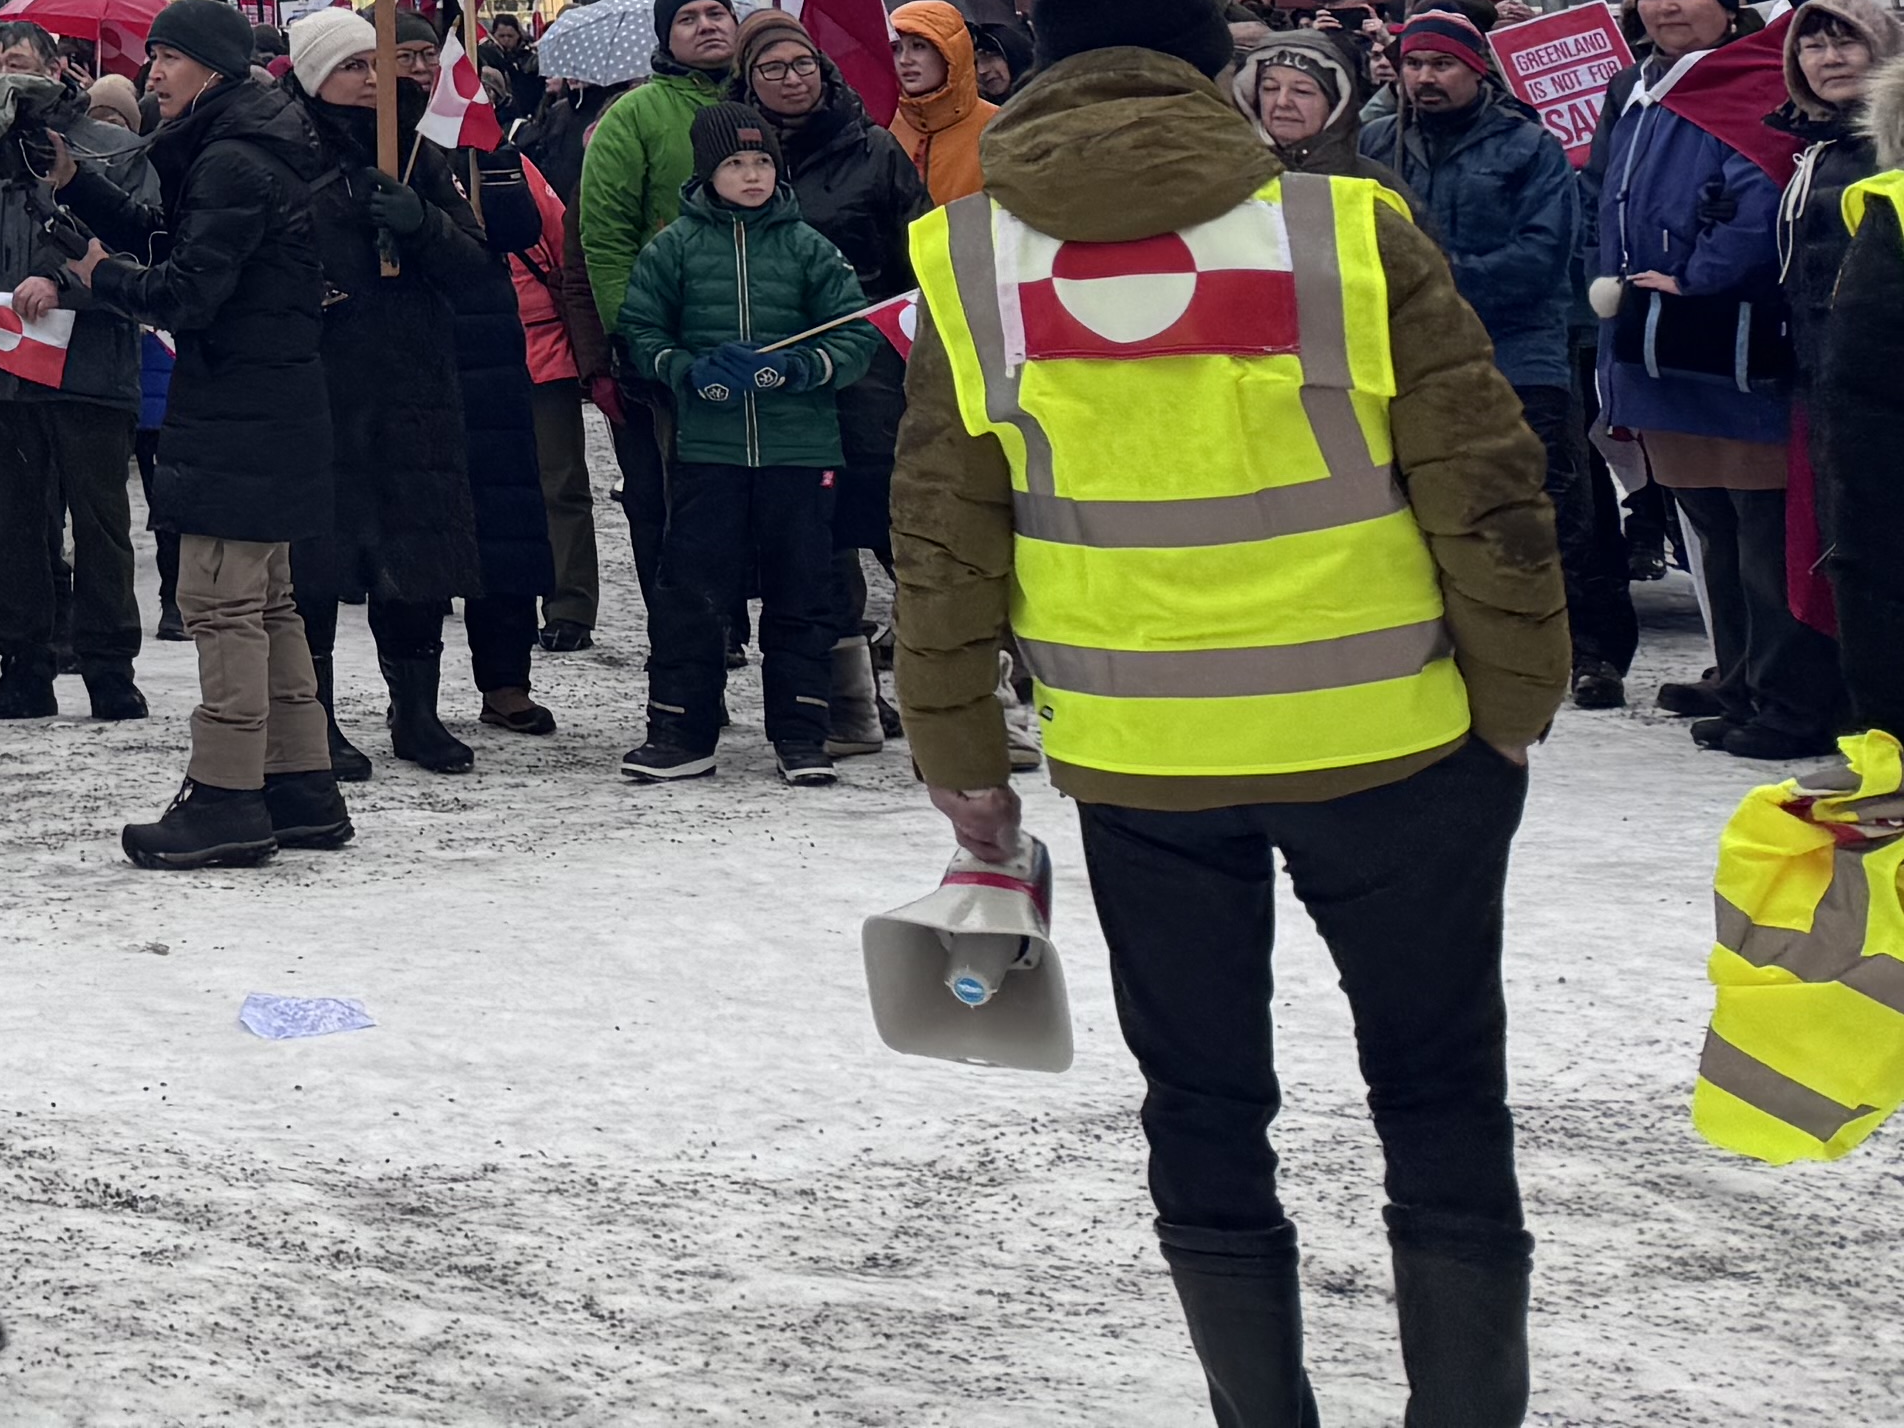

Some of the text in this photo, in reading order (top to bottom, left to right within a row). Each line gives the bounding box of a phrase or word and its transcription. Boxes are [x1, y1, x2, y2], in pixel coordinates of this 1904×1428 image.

[1516, 32, 1607, 73] GREENLAND
[1528, 60, 1618, 101] IS NOT FOR
